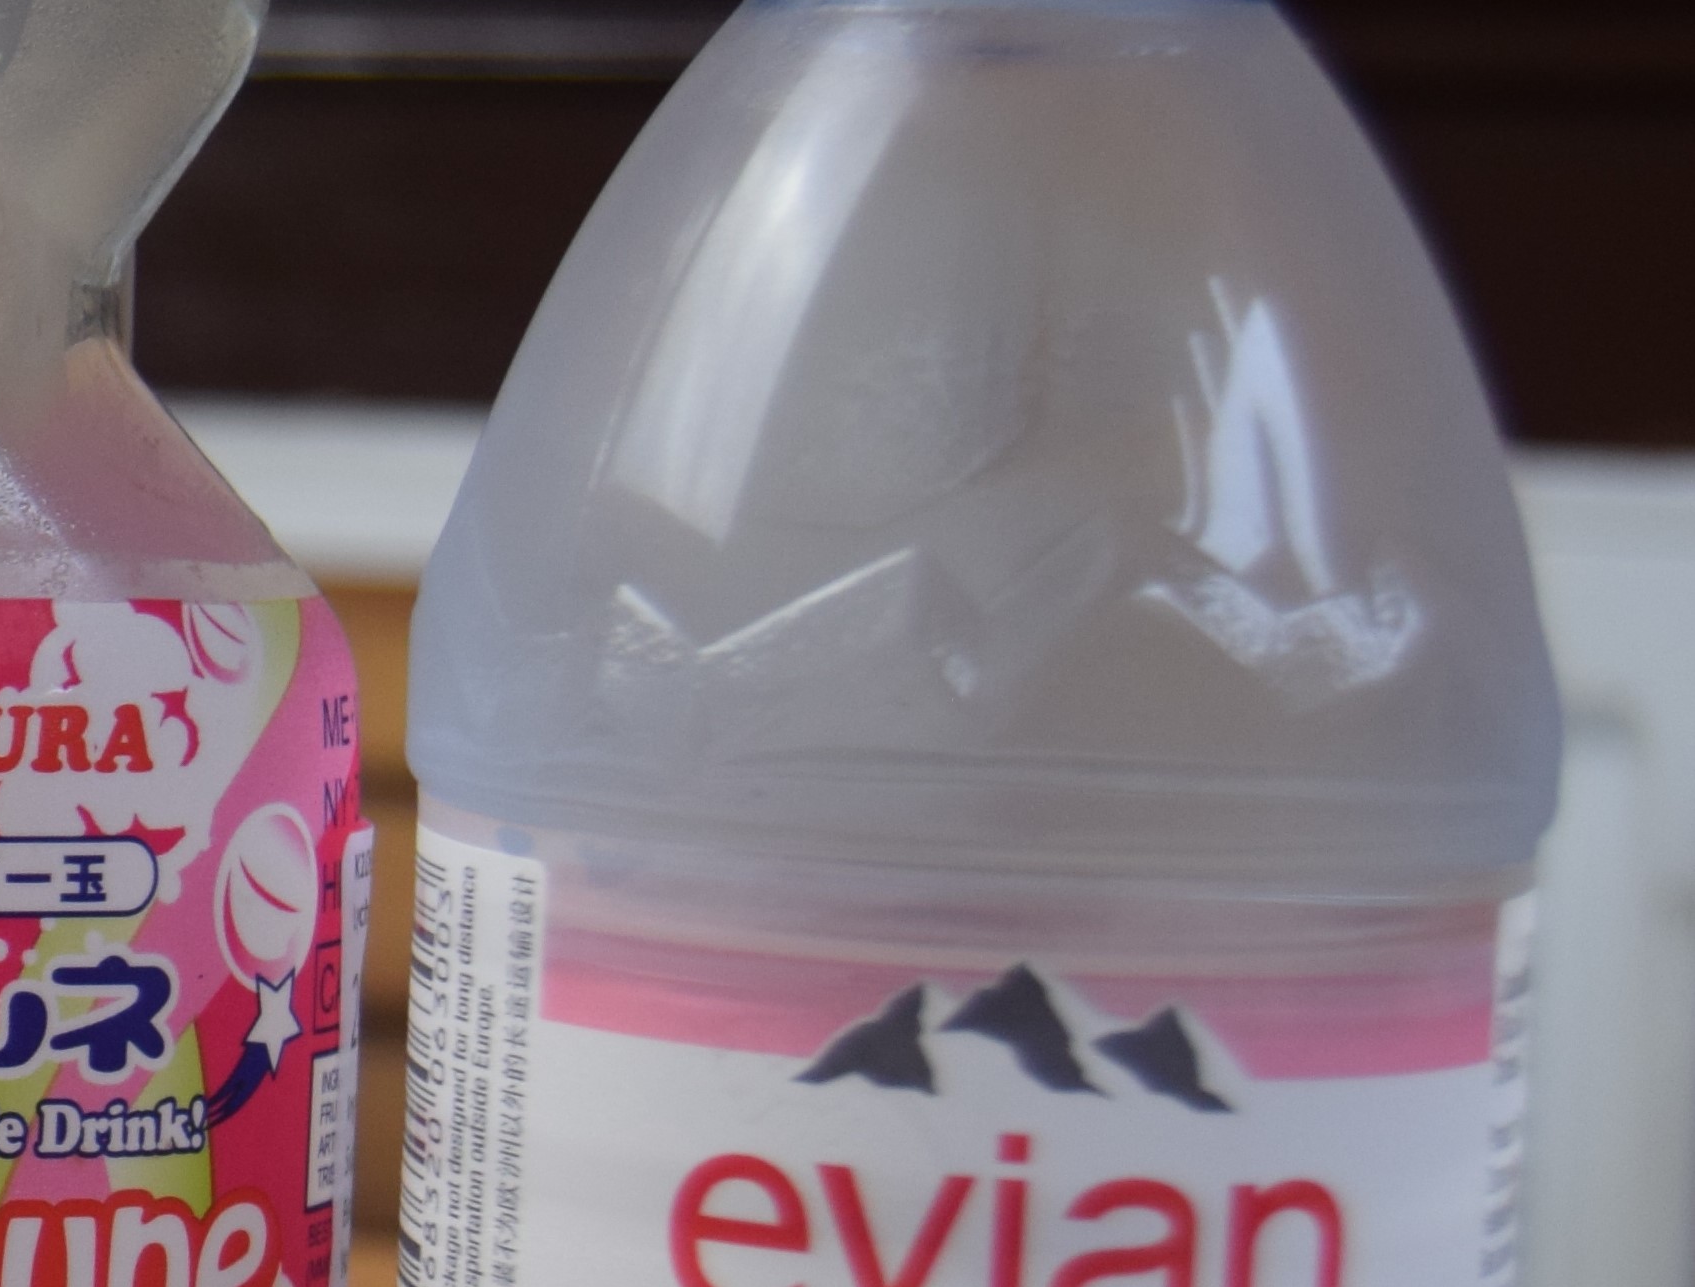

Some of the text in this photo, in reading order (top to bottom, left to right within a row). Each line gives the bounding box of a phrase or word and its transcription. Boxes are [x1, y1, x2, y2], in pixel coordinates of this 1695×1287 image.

[457, 866, 478, 963] distance
[454, 969, 475, 1022] long
[452, 1029, 469, 1060] for
[36, 1092, 208, 1158] Drink!
[448, 1069, 468, 1172] designed
[468, 1077, 489, 1159] outside
[446, 1176, 462, 1217] not
